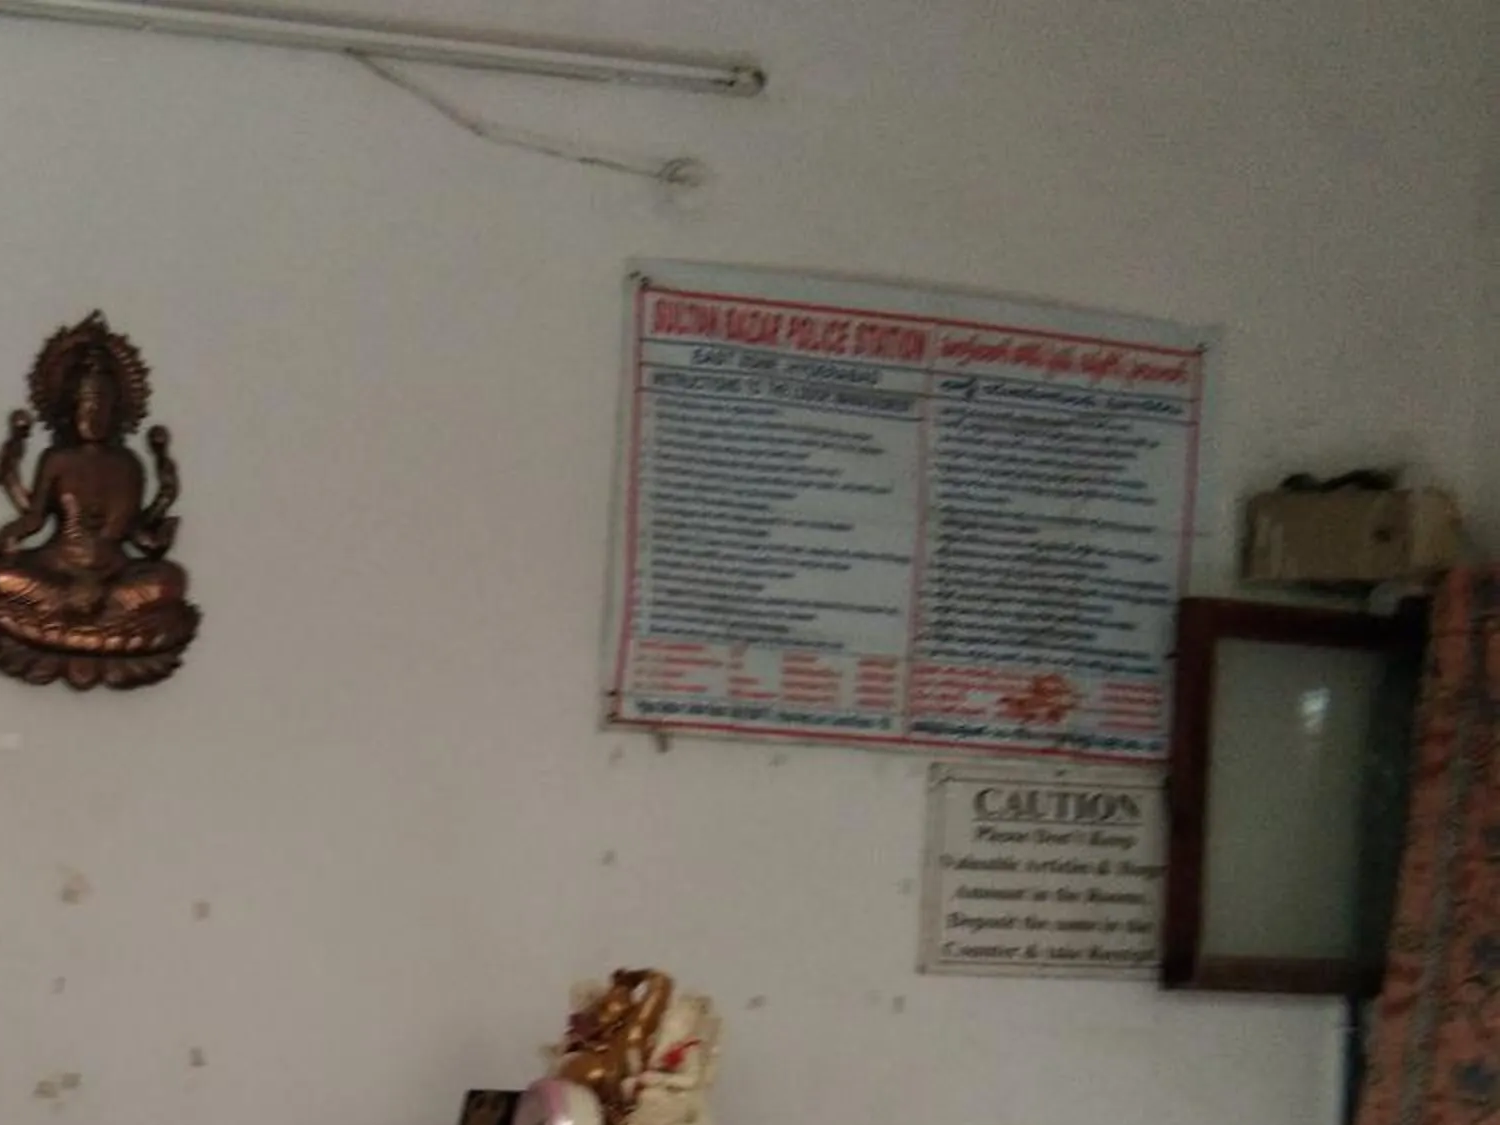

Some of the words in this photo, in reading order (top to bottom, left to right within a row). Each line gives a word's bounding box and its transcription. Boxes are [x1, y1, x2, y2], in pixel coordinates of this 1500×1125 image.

[786, 315, 851, 354] POLICE
[854, 322, 927, 361] STATION
[973, 787, 1143, 820] CAUTION
